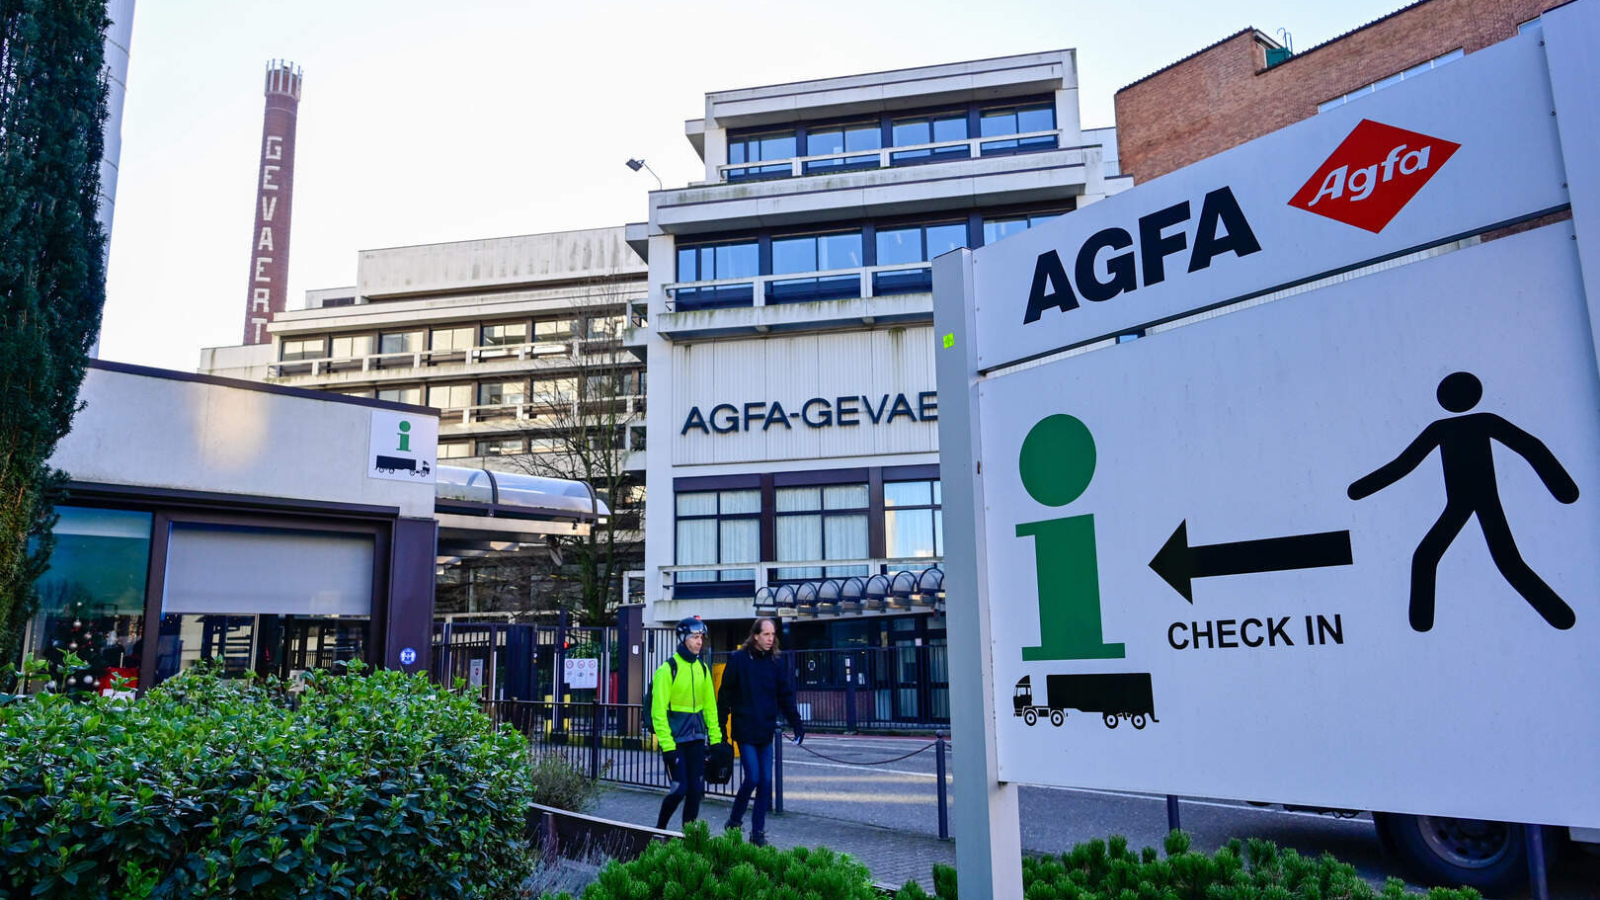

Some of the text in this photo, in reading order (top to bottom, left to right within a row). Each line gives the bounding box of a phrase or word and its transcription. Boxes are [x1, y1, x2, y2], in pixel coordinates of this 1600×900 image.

[1307, 143, 1431, 207] Agfa
[251, 135, 283, 344] GEVAERT
[1023, 185, 1262, 325] AGFA
[681, 390, 938, 436] AGFA-GEVAE
[1167, 613, 1344, 650] CHECK IN
